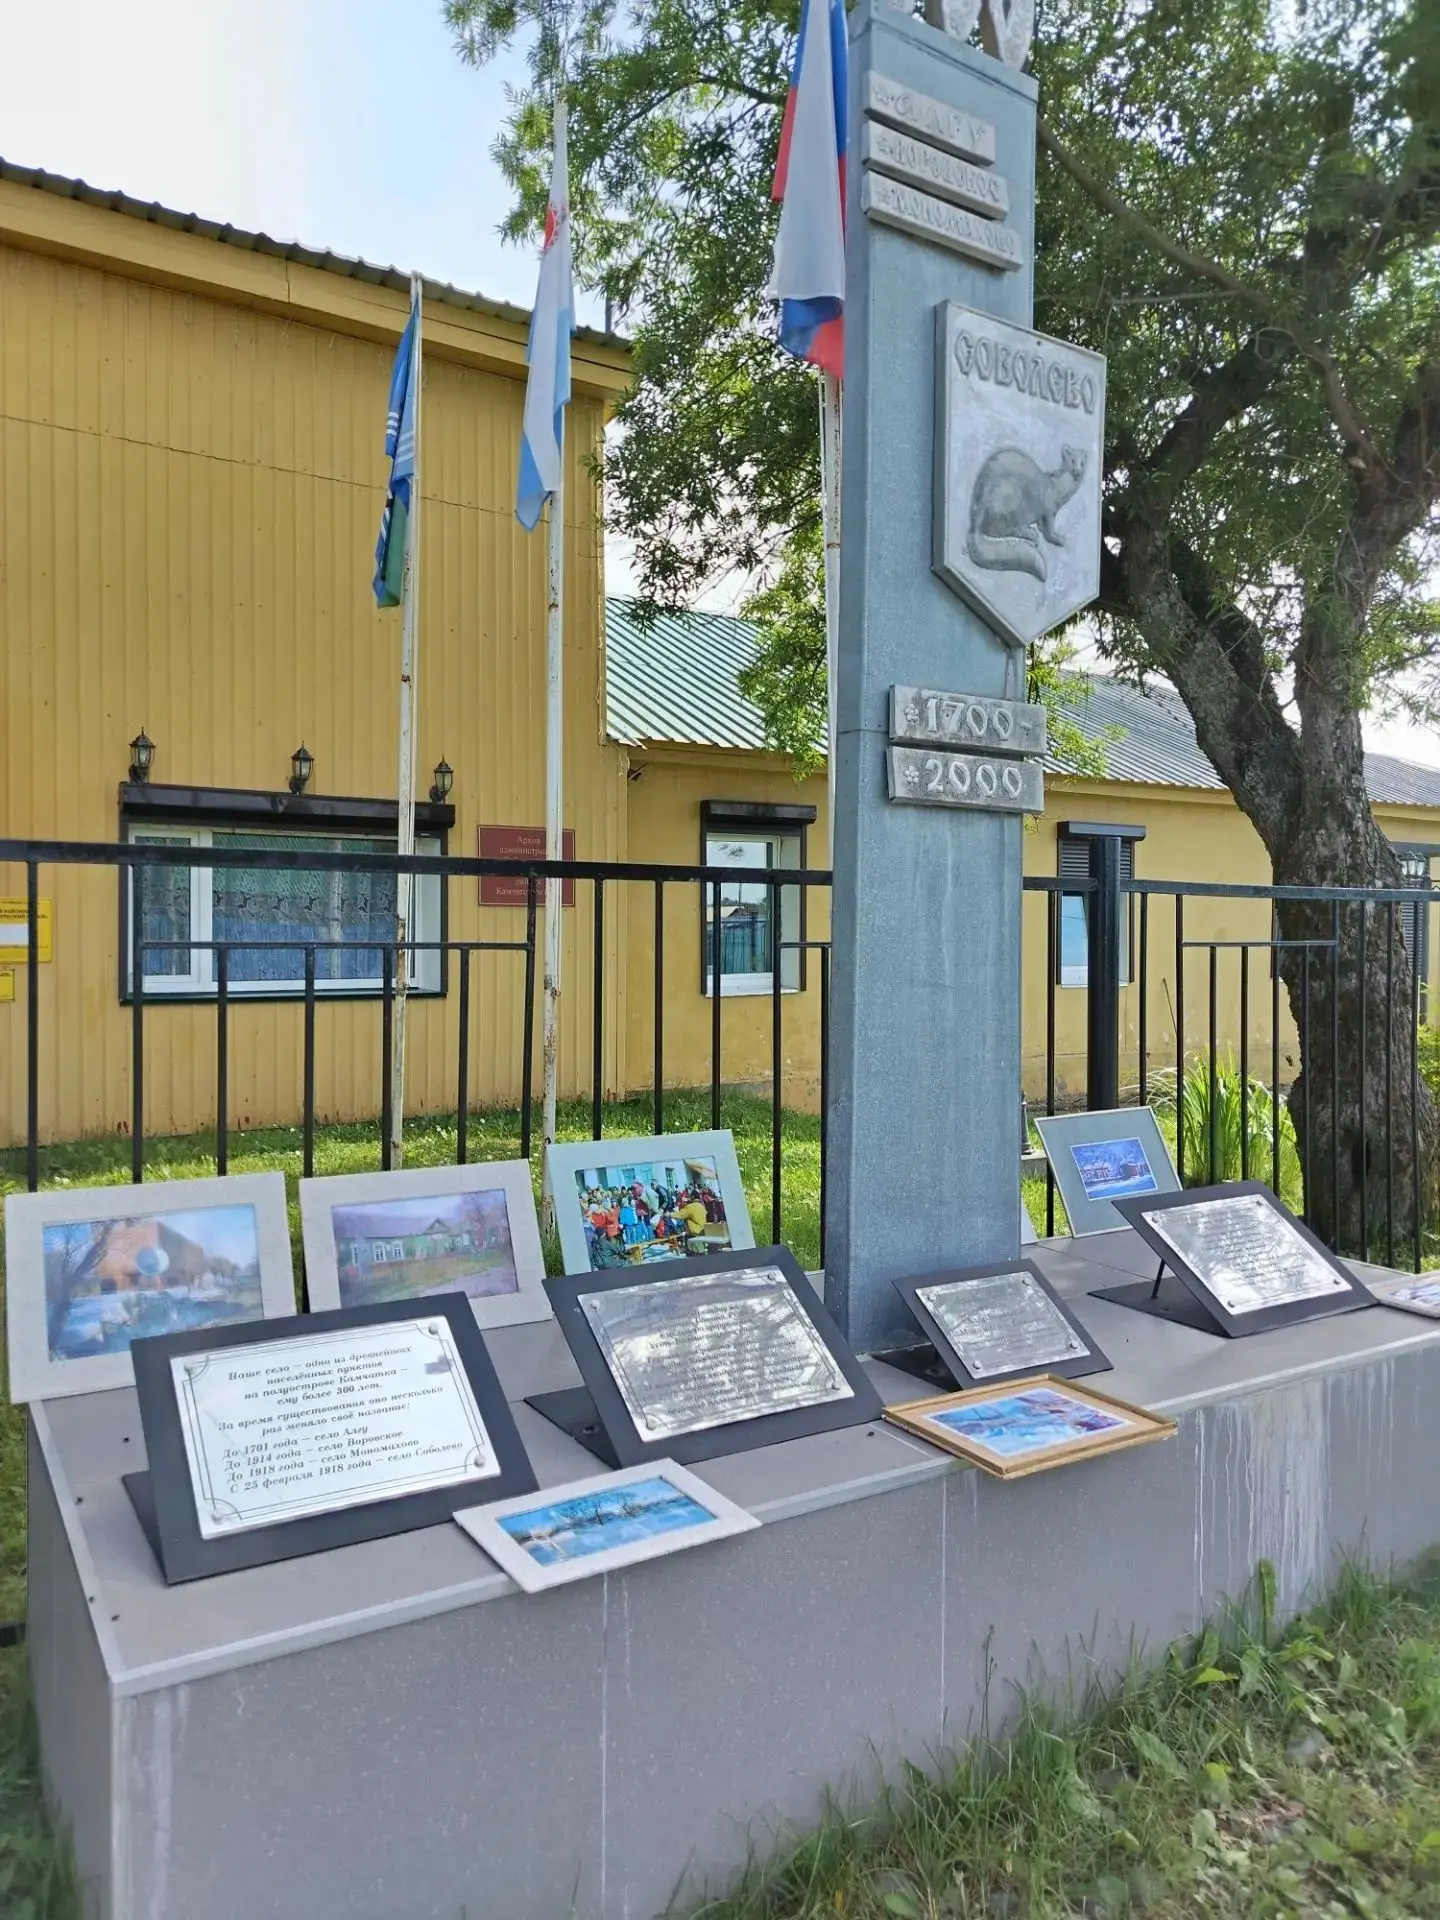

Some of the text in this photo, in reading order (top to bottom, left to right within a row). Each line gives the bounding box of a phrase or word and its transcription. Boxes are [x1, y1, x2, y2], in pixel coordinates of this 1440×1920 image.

[954, 330, 1096, 415] СОБОЛЕВО
[925, 758, 1023, 799] 2000
[228, 1371, 261, 1381] Наше
[265, 1366, 290, 1375] село
[305, 1360, 330, 1368] одно
[263, 1380, 335, 1397] полуострове
[339, 1369, 397, 1384] Камчатка
[267, 1361, 383, 1385] населённых пунктов
[277, 1396, 298, 1405] ему
[302, 1391, 332, 1400] более
[336, 1384, 355, 1395] 300
[218, 1422, 234, 1431] За
[238, 1416, 273, 1429] время
[277, 1400, 365, 1422] существования
[368, 1396, 387, 1405] оно
[262, 1426, 282, 1437] раз
[286, 1418, 328, 1430] меняло
[331, 1411, 354, 1422] своё
[222, 1449, 238, 1460] До
[244, 1442, 268, 1456] 1701
[273, 1438, 298, 1449] года
[314, 1432, 339, 1441] село
[343, 1426, 368, 1436] Алгу
[224, 1460, 241, 1472] До
[247, 1453, 272, 1466] 1914
[276, 1449, 302, 1460] года
[318, 1443, 343, 1452] село
[347, 1431, 402, 1447] Воровское
[227, 1472, 243, 1484] До
[250, 1465, 276, 1477] 1918
[278, 1460, 304, 1472] года
[321, 1454, 346, 1463] село
[350, 1440, 419, 1458] Мономахово
[230, 1483, 238, 1493] С
[244, 1480, 258, 1491] 25
[262, 1472, 313, 1489] февраля
[319, 1464, 344, 1476] 1918
[347, 1459, 372, 1470] года
[388, 1452, 412, 1462] село
